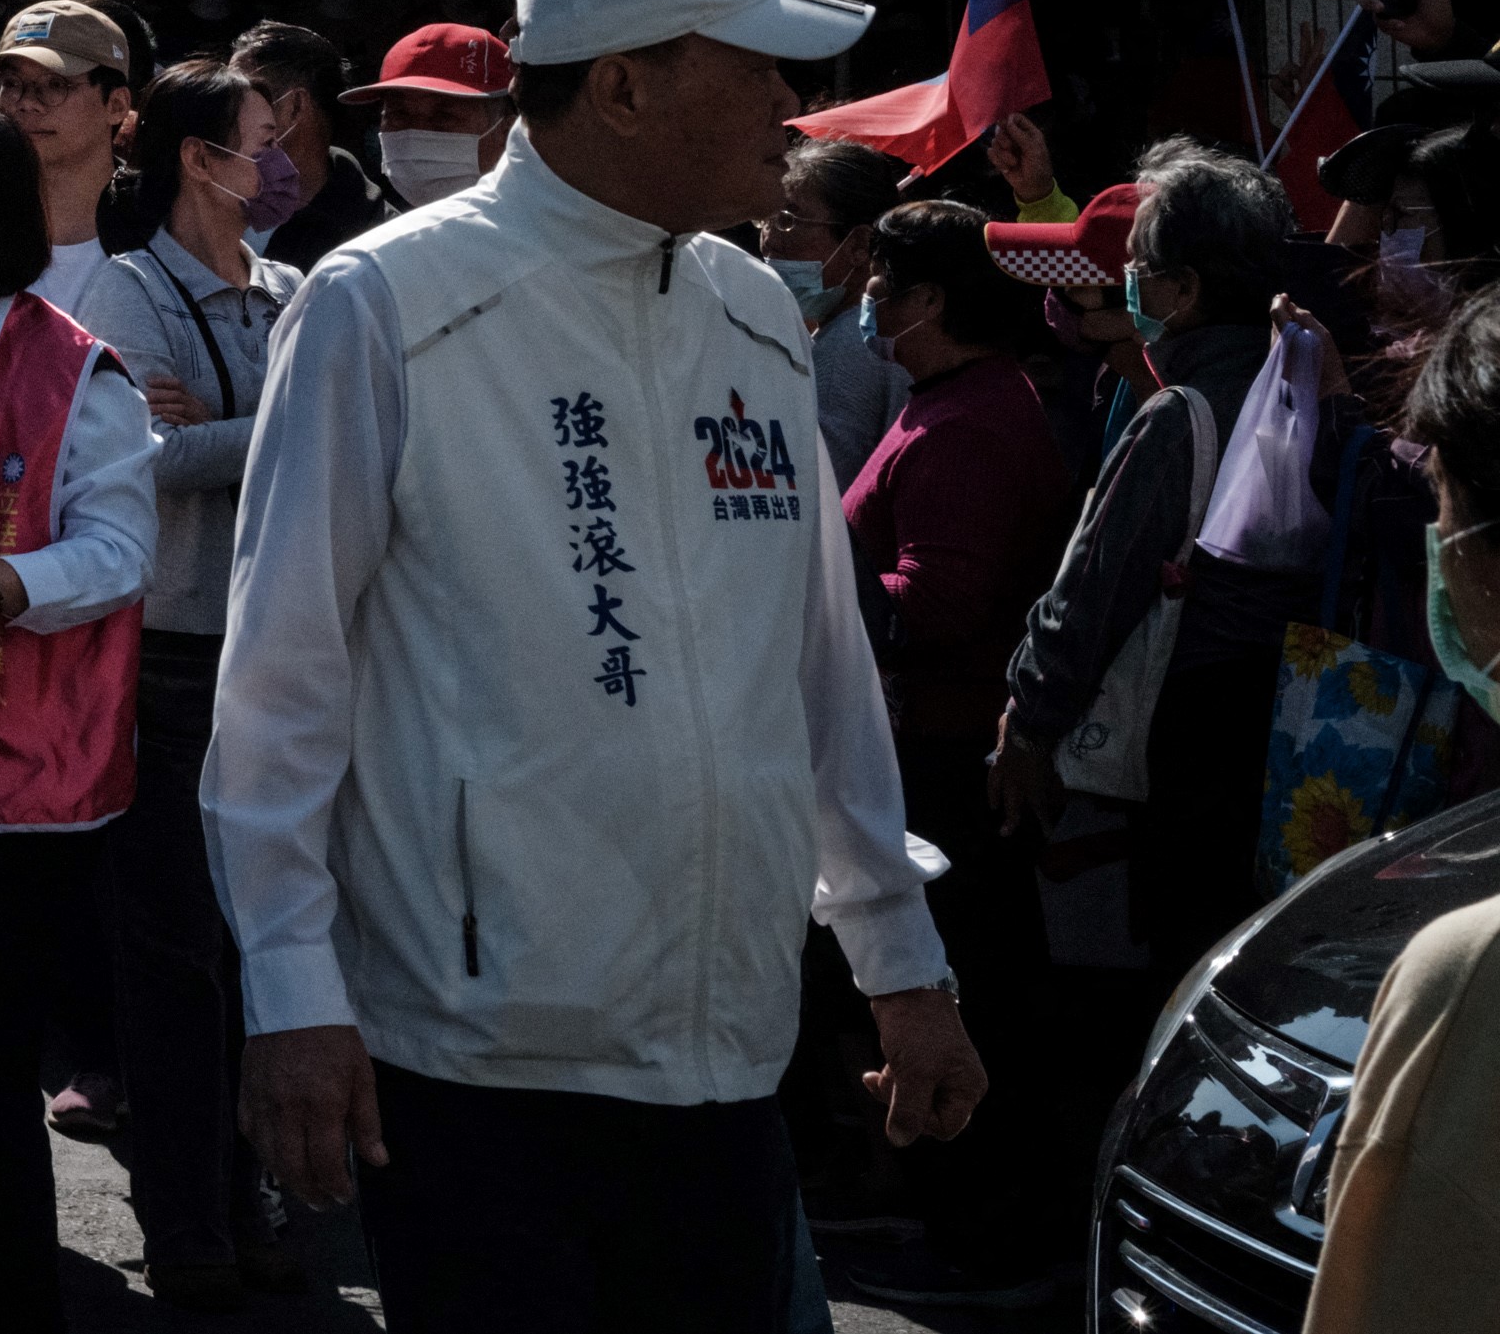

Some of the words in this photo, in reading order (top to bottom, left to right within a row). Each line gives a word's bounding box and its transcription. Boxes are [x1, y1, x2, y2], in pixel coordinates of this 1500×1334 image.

[550, 390, 648, 708] 強強滾大哥
[713, 493, 801, 522] 台灣再出發
